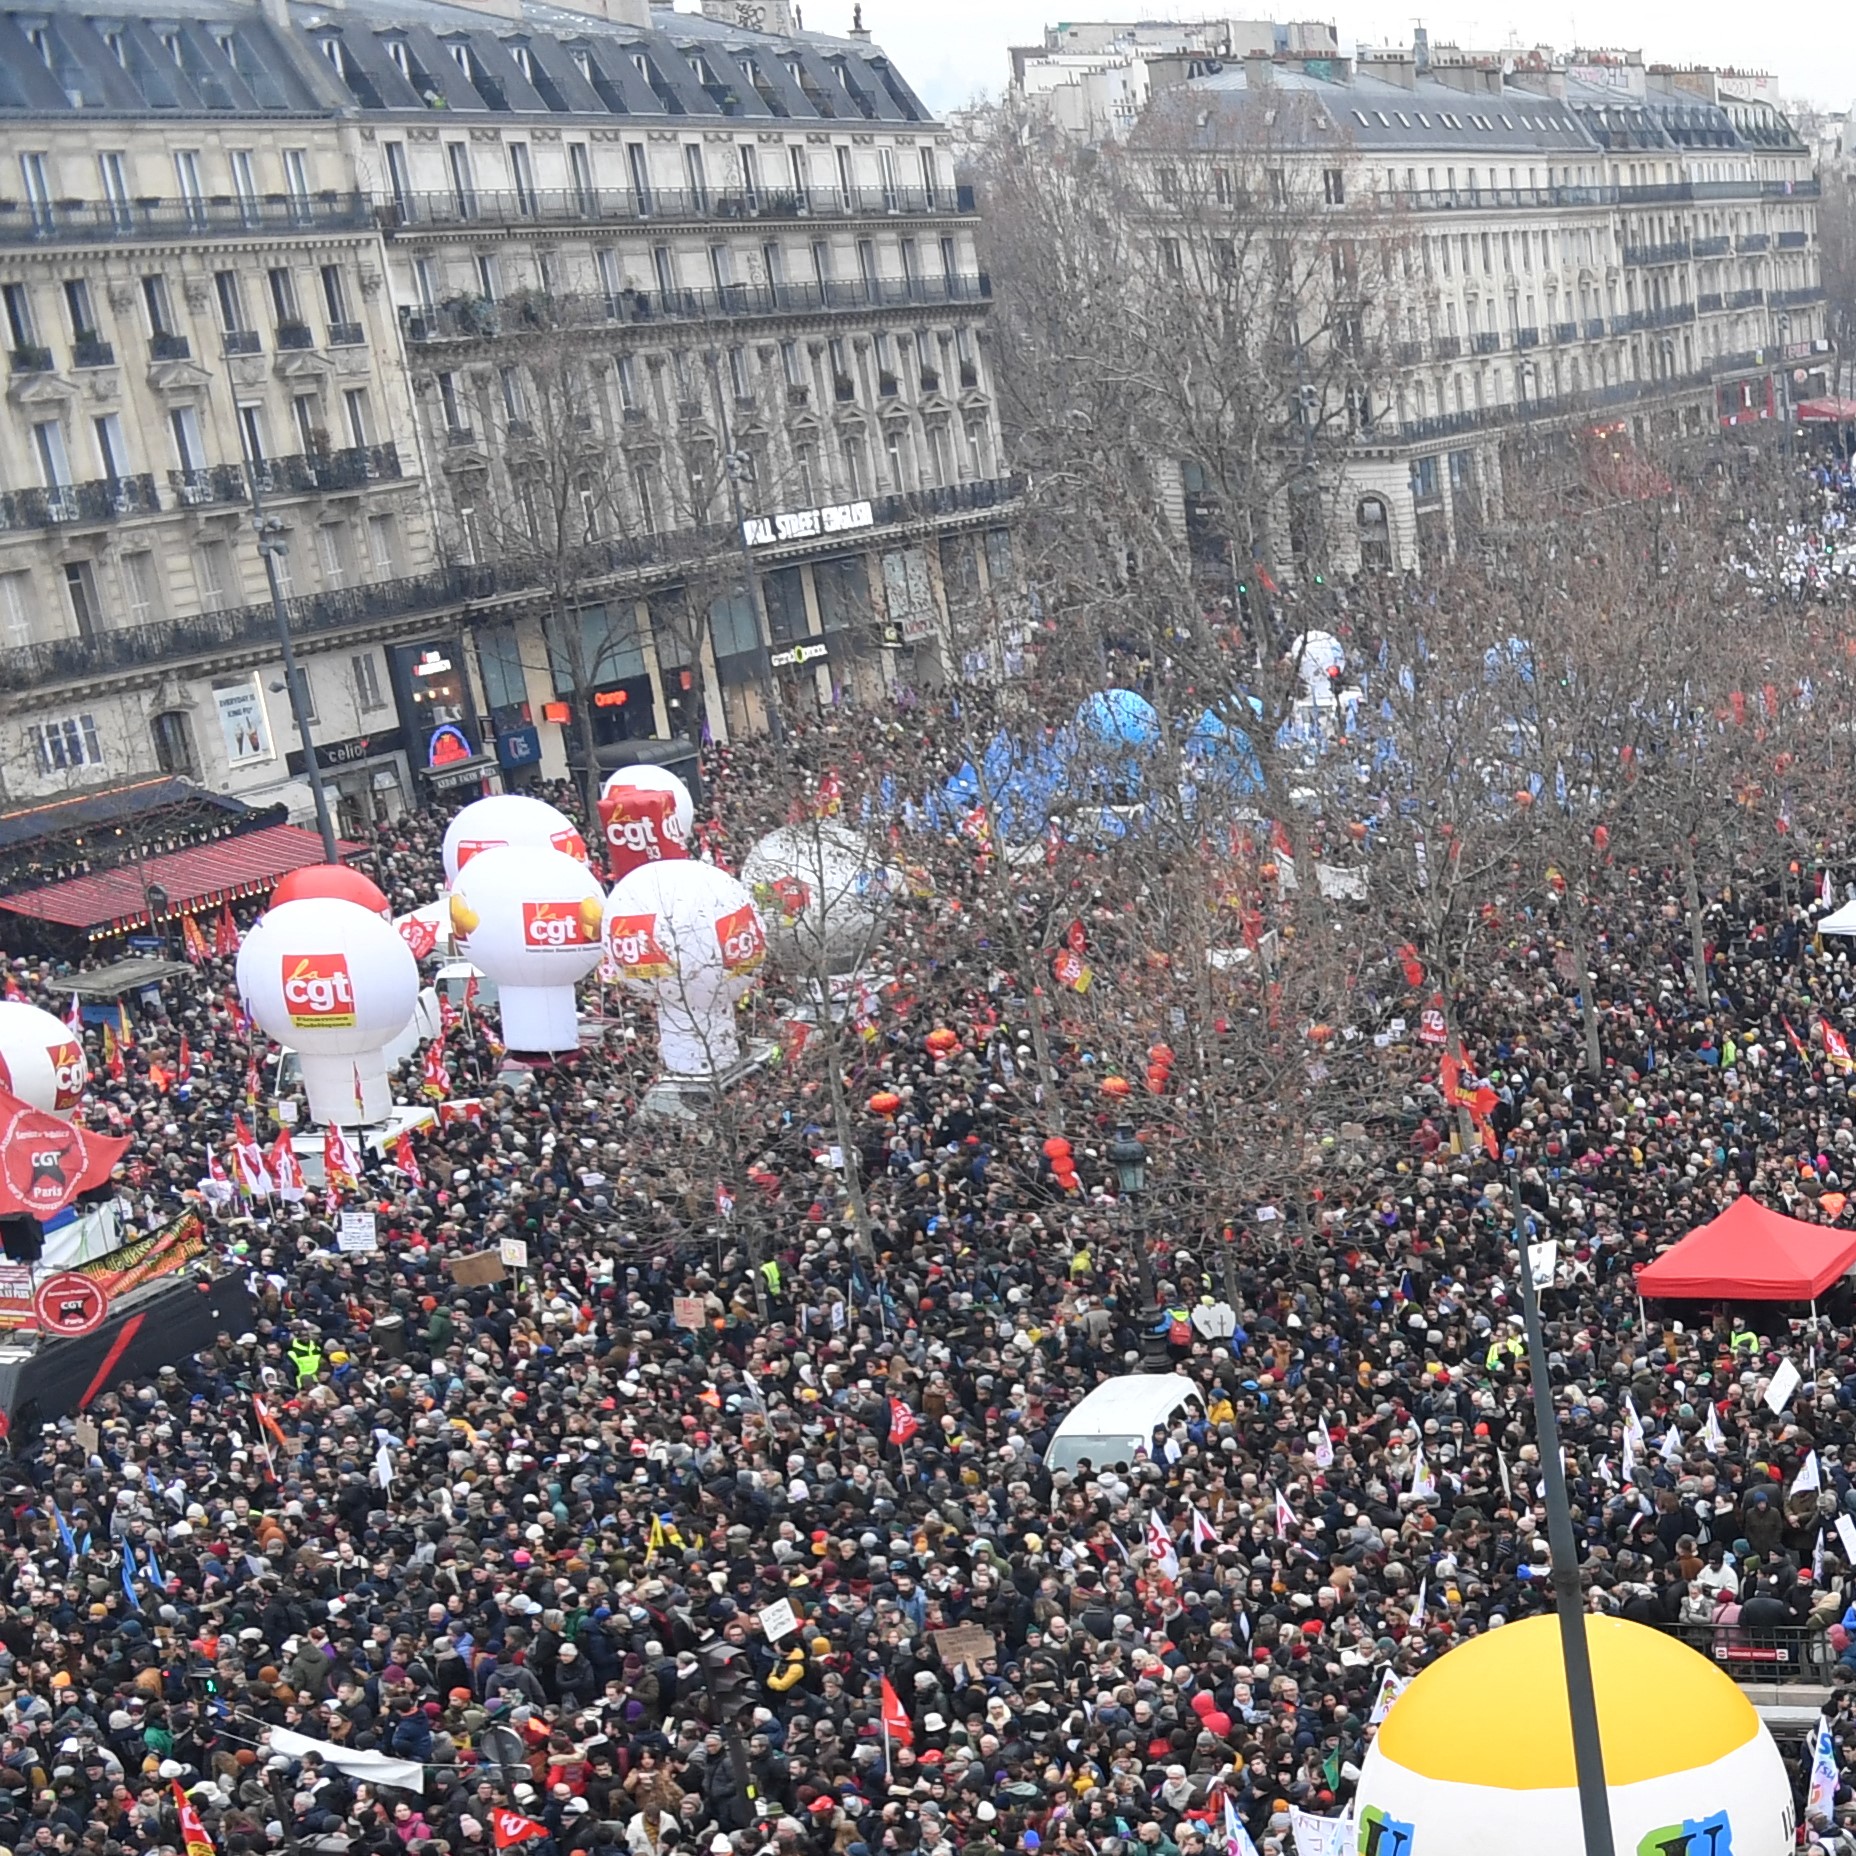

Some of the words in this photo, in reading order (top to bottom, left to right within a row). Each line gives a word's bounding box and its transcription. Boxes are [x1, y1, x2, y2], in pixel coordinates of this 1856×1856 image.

[777, 509, 822, 540] STREET
[823, 501, 874, 533] ENGLISH
[607, 815, 659, 852] cgt
[646, 846, 661, 861] 93
[530, 915, 577, 944] cgt
[613, 930, 650, 964] cgt
[285, 971, 354, 1011] cgt
[31, 1151, 61, 1166] CGT
[33, 1186, 62, 1198] Paris
[60, 1301, 83, 1310] CGT
